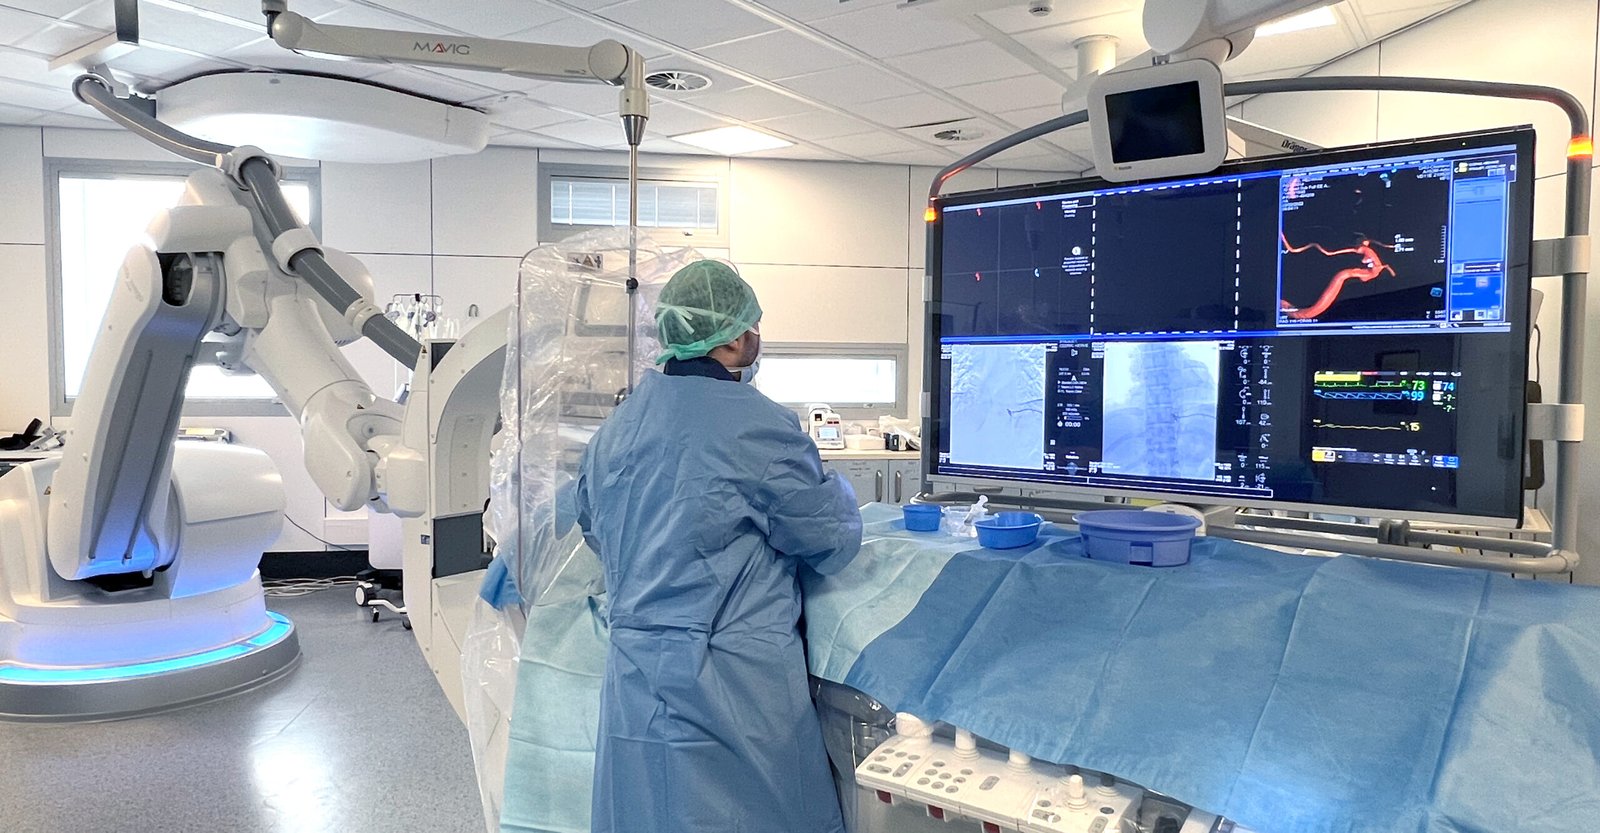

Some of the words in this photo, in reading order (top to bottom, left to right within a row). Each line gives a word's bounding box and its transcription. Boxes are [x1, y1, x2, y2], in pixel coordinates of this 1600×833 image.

[413, 42, 470, 55] MAVIG
[1412, 380, 1425, 390] 73
[1442, 382, 1454, 391] 74
[1411, 391, 1424, 401] 99
[1410, 422, 1420, 432] 15
